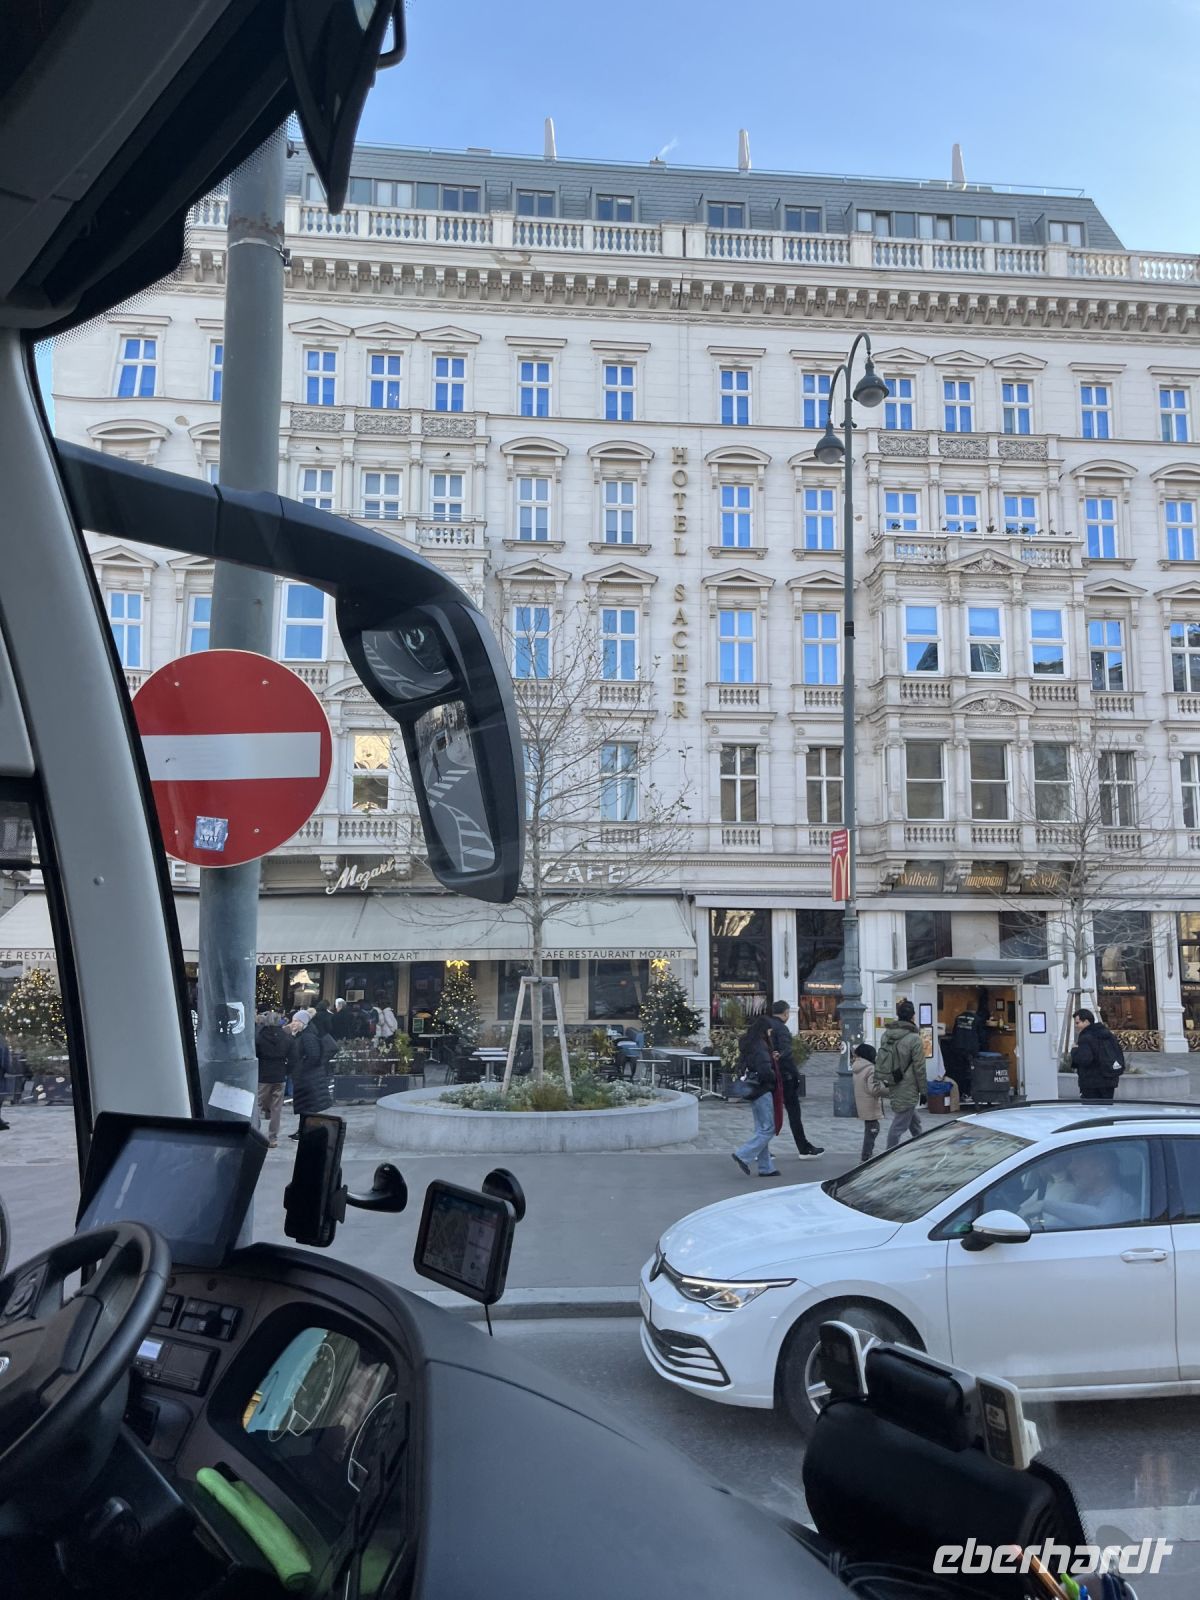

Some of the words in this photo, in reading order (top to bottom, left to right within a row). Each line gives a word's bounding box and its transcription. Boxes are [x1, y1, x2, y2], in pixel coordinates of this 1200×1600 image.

[671, 446, 689, 556] HOTEL
[671, 583, 689, 719] SACHER
[325, 856, 395, 895] Mozart
[291, 951, 369, 964] RESTAURANT
[373, 951, 420, 961] MOZART
[568, 950, 636, 959] RESTAURANT
[639, 950, 683, 959] MOZART
